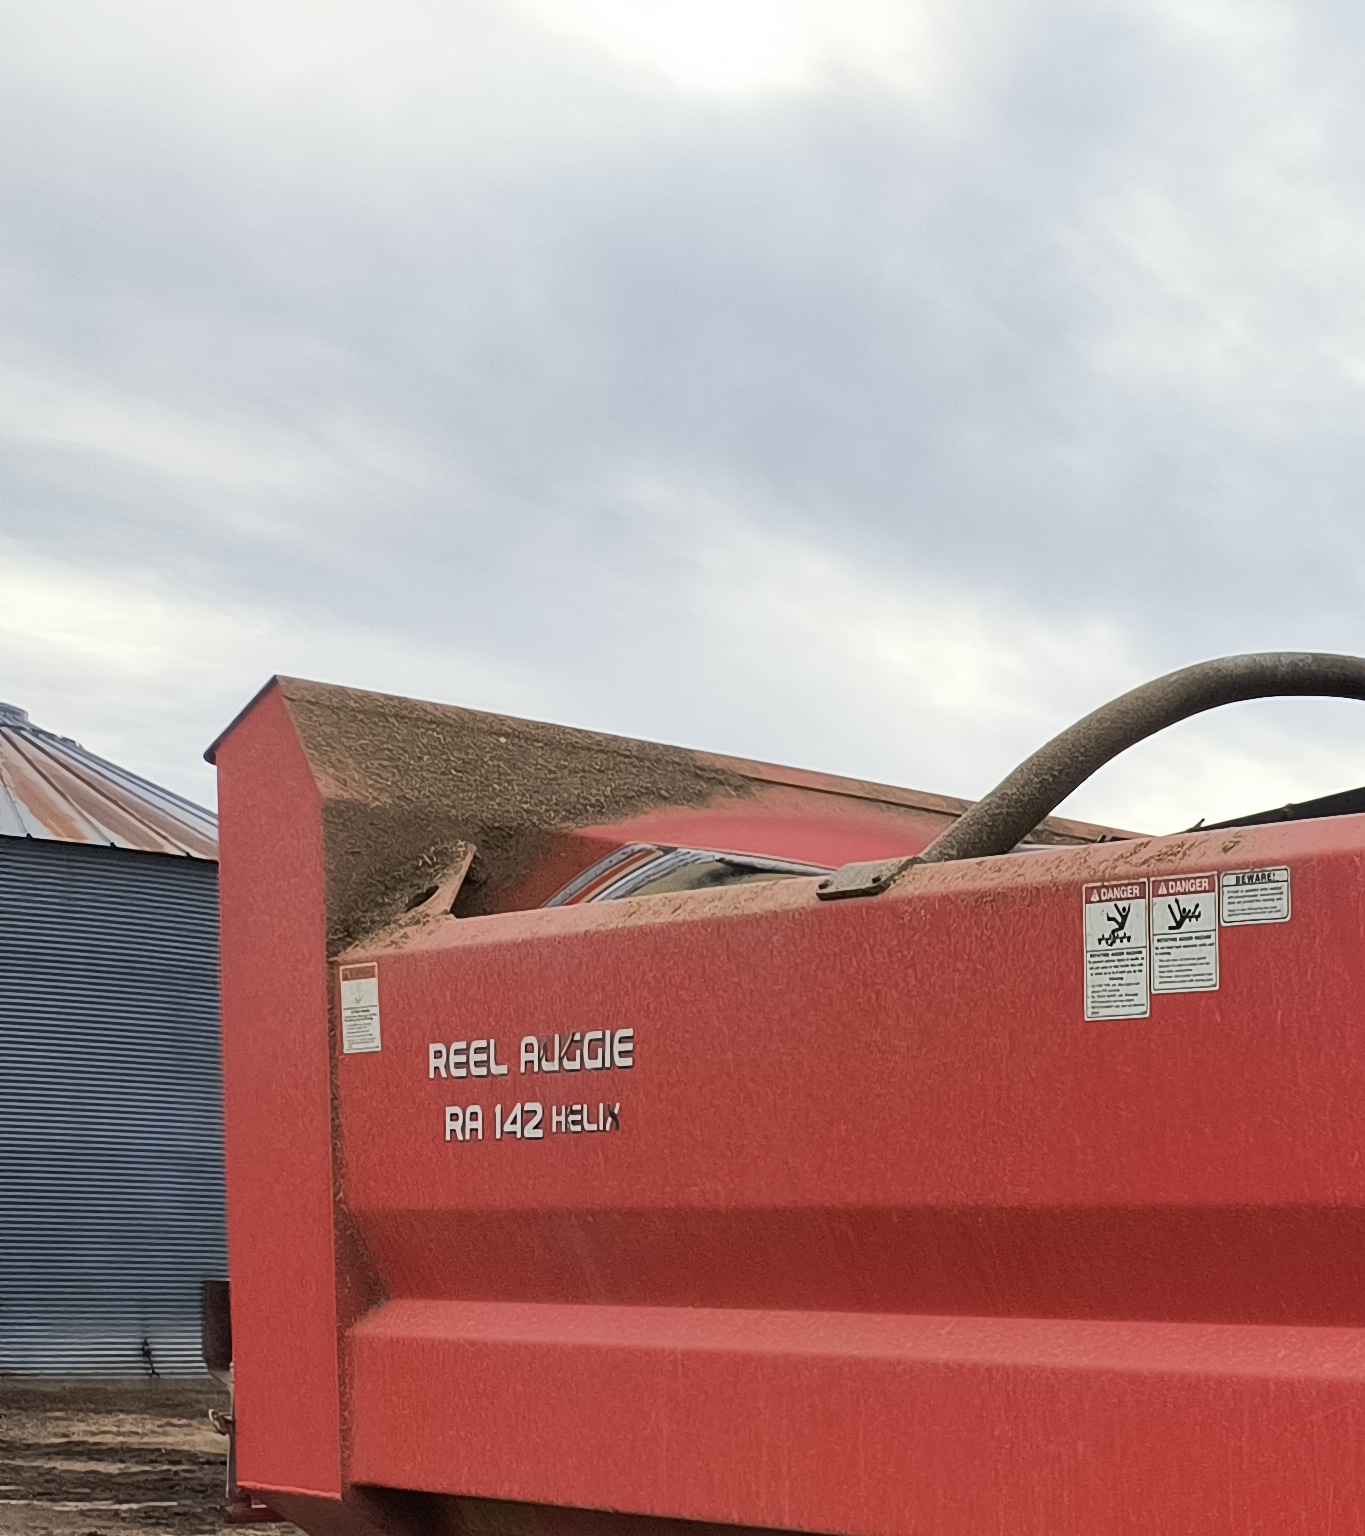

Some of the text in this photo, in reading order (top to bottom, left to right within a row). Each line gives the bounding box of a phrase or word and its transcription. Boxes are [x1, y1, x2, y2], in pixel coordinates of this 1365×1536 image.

[1100, 885, 1140, 899] DANGER
[1168, 878, 1209, 893] DANGER
[429, 1028, 634, 1079] REEL AUGGIE
[445, 1102, 620, 1141] RA 142 HELIX
